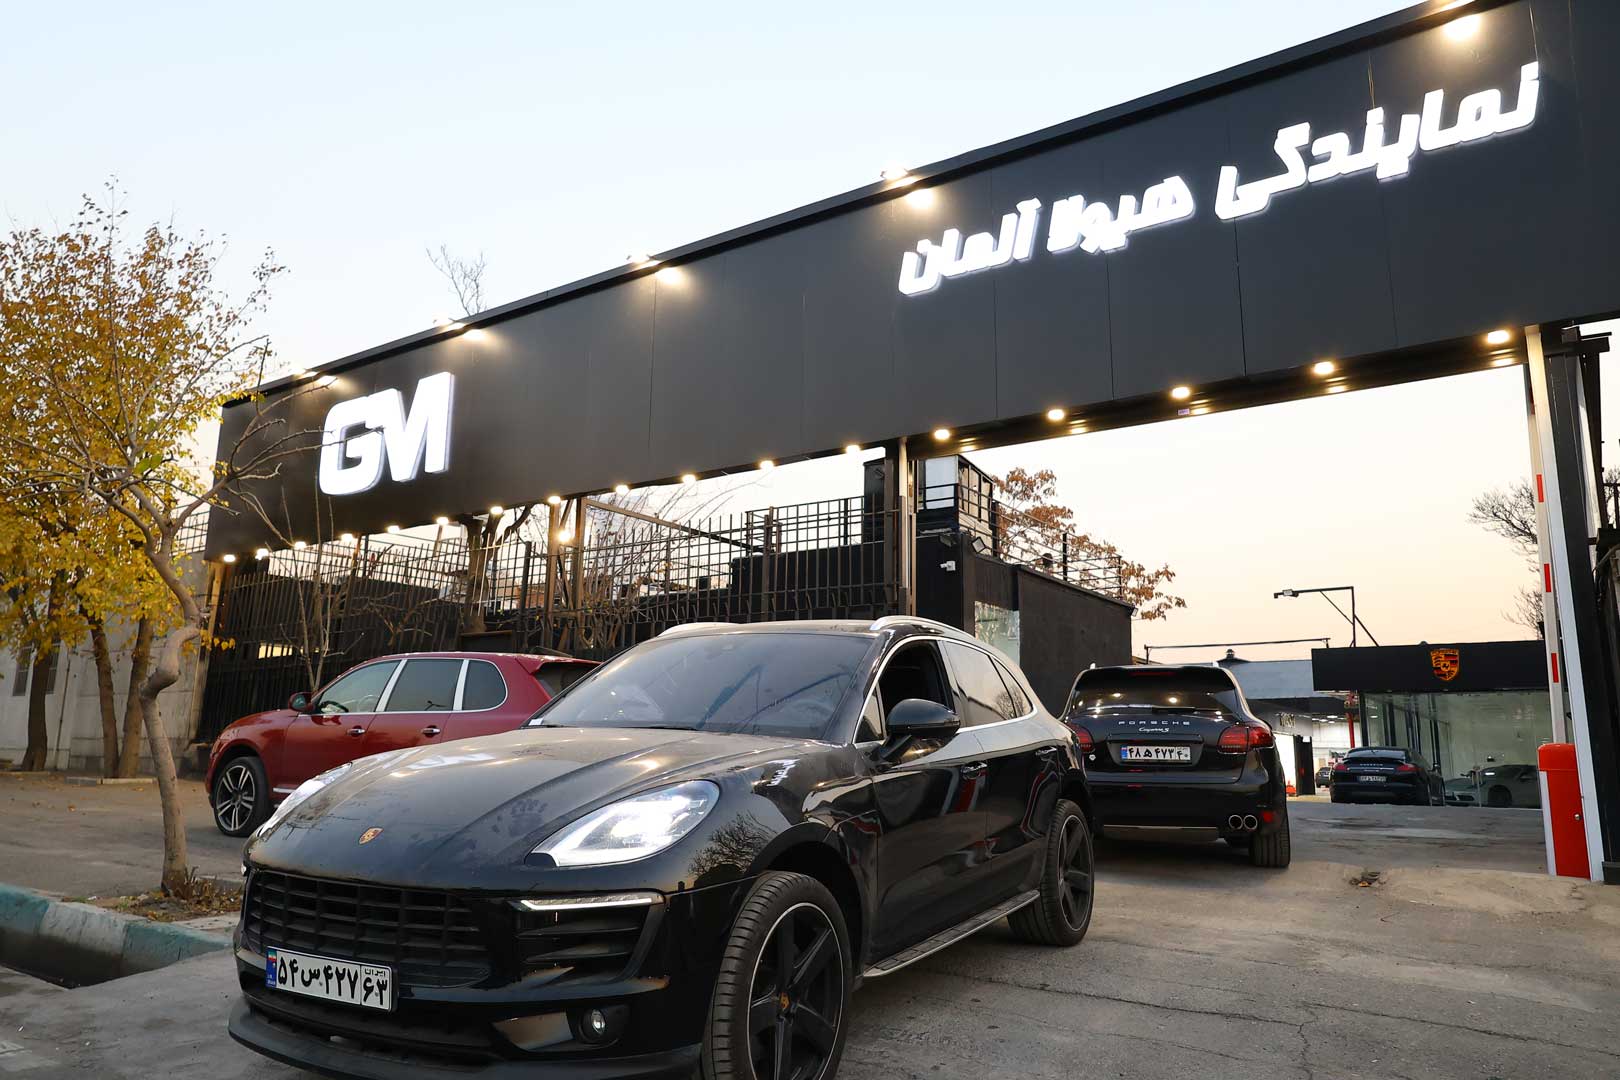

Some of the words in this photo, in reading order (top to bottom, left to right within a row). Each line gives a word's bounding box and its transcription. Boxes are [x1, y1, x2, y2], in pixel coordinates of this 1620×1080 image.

[1214, 60, 1540, 220] نمایندگی
[898, 198, 1042, 296] آلمان
[1047, 175, 1195, 254] هیولا
[319, 371, 454, 495] GM
